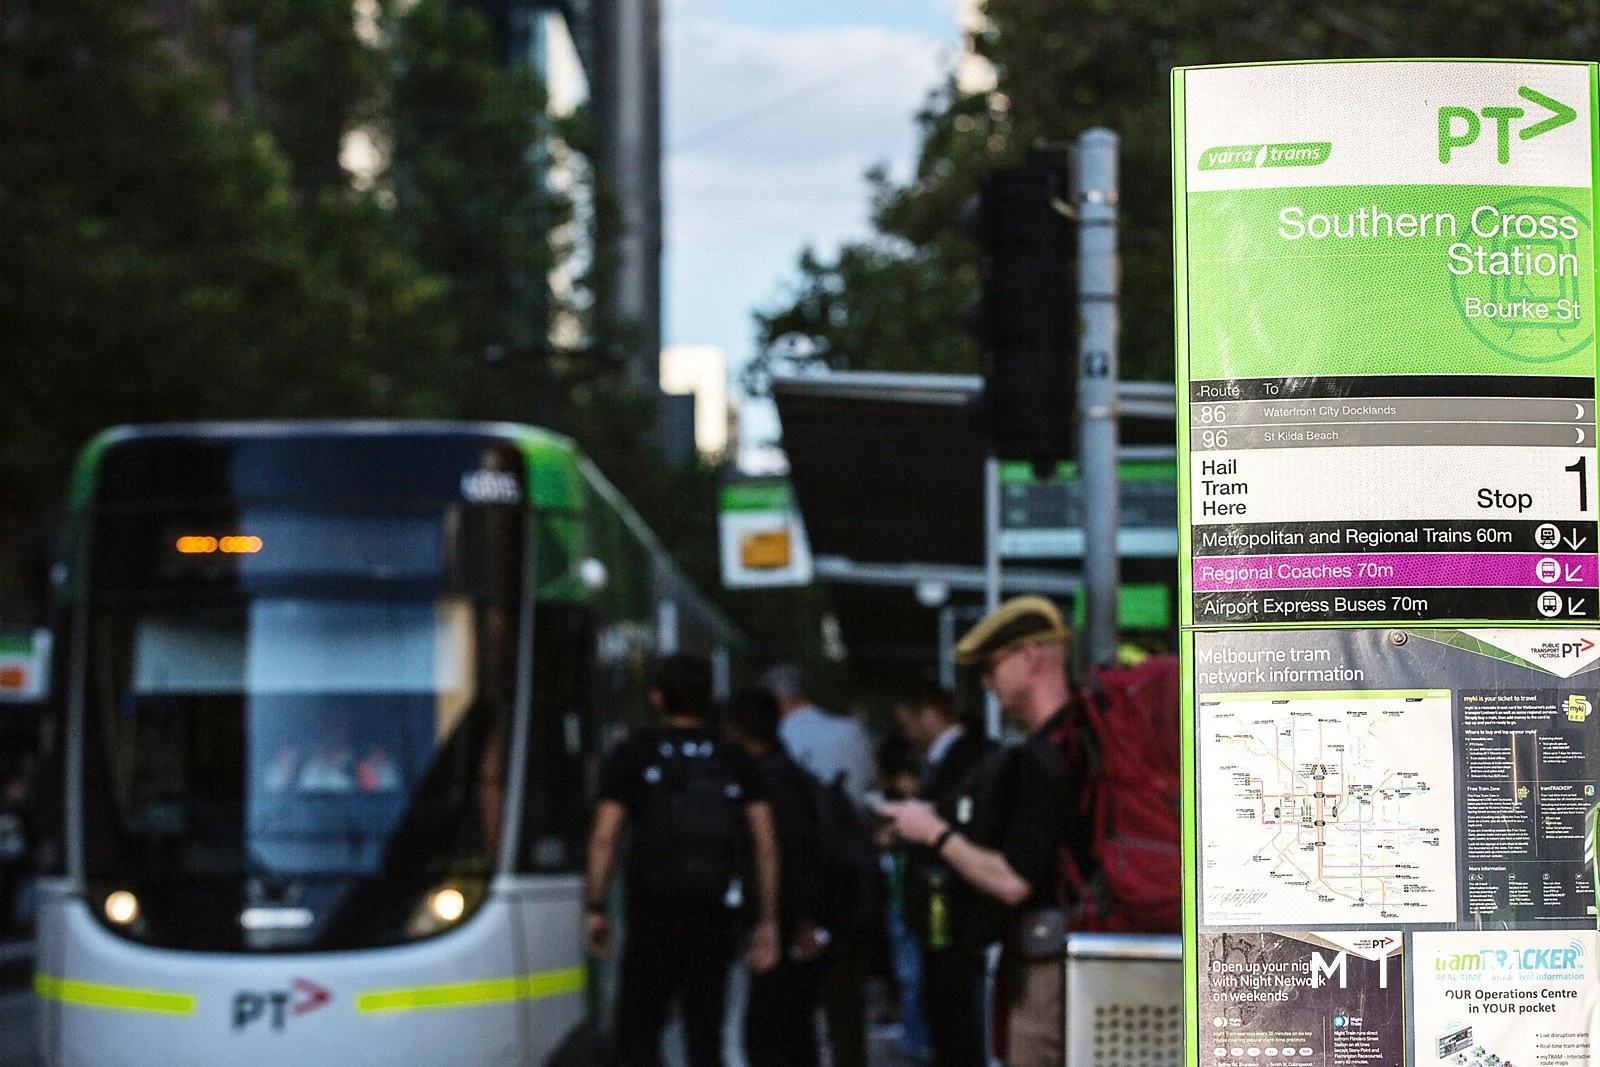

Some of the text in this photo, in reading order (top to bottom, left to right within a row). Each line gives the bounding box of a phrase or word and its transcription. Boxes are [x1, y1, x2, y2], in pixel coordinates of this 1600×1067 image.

[1208, 147, 1321, 168] yarra trams
[1278, 205, 1579, 240] Southern Cross
[1447, 242, 1578, 277] Station
[1465, 298, 1580, 320] Bourke St
[1200, 383, 1279, 398] Route To
[1200, 405, 1227, 424] 86
[1263, 404, 1397, 418] Waterfront City Docklands
[1202, 429, 1228, 448] 96
[1264, 430, 1339, 442] St Kilda Beach
[1202, 459, 1237, 476] Hail
[1202, 480, 1248, 496] Tram
[1477, 456, 1588, 513] Stop 1
[1203, 500, 1247, 517] Here
[1202, 527, 1513, 548] Metropolitan and Regional Trains 60m
[1202, 562, 1394, 582] Regional Coaches 70m
[1203, 597, 1428, 618] Airport Express Buses 70m
[1198, 647, 1331, 663] Melbourne tram
[1198, 666, 1364, 683] network information
[1212, 960, 1321, 974] Open up your nig
[1213, 975, 1326, 988] with Night Netwok
[1537, 973, 1584, 981] information
[1213, 990, 1289, 1002] on weekends
[1475, 989, 1538, 1001] Operations
[1541, 988, 1577, 999] Centre
[1468, 1003, 1556, 1014] in YOUR pocket
